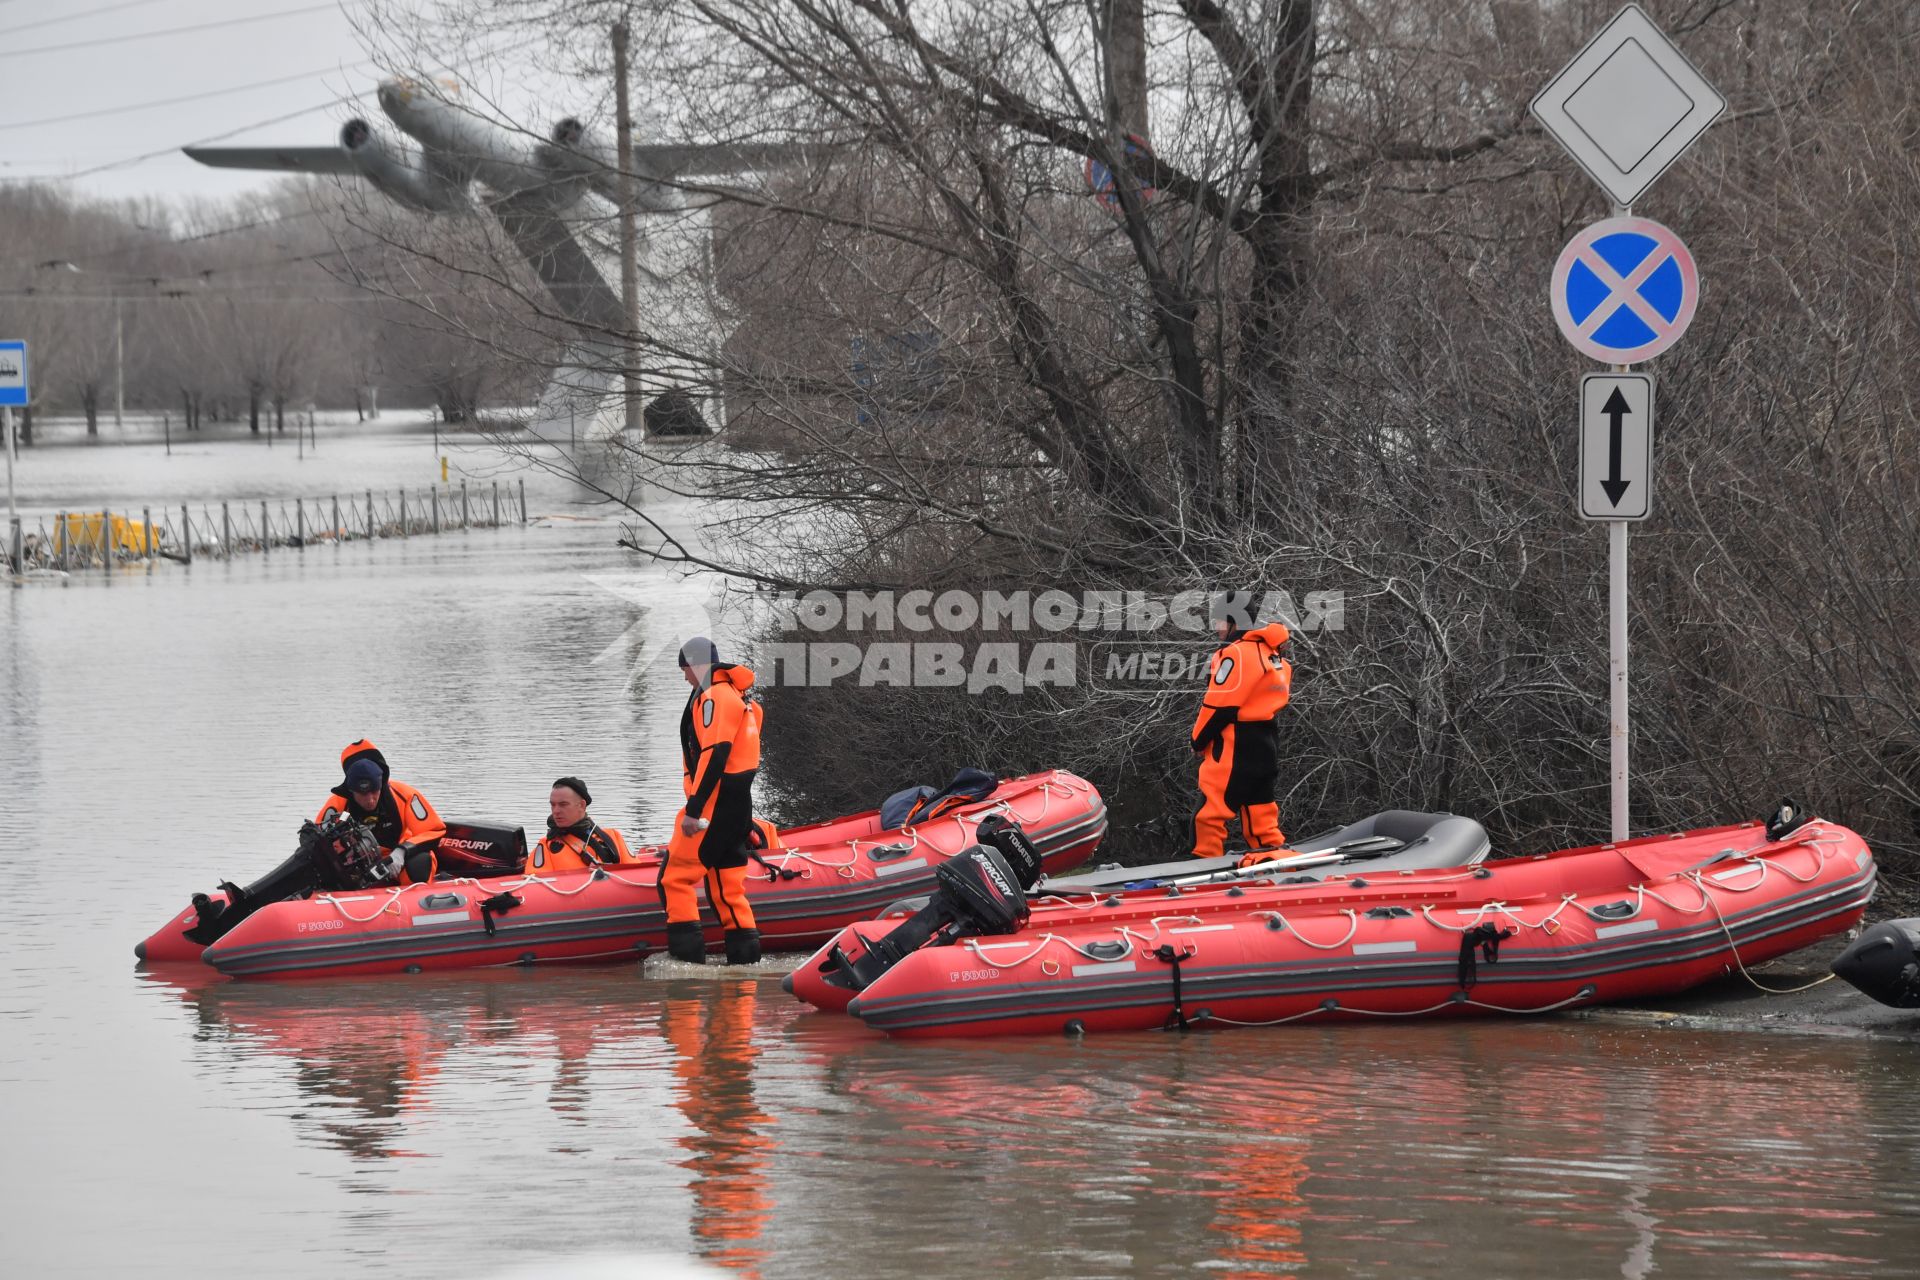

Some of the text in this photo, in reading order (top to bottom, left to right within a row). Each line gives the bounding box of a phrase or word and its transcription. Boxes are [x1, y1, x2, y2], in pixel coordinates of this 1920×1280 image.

[1008, 832, 1035, 868] TOHATSU
[970, 853, 1014, 897] MERCURY
[298, 922, 307, 932] F
[950, 968, 1000, 982] F 500D
